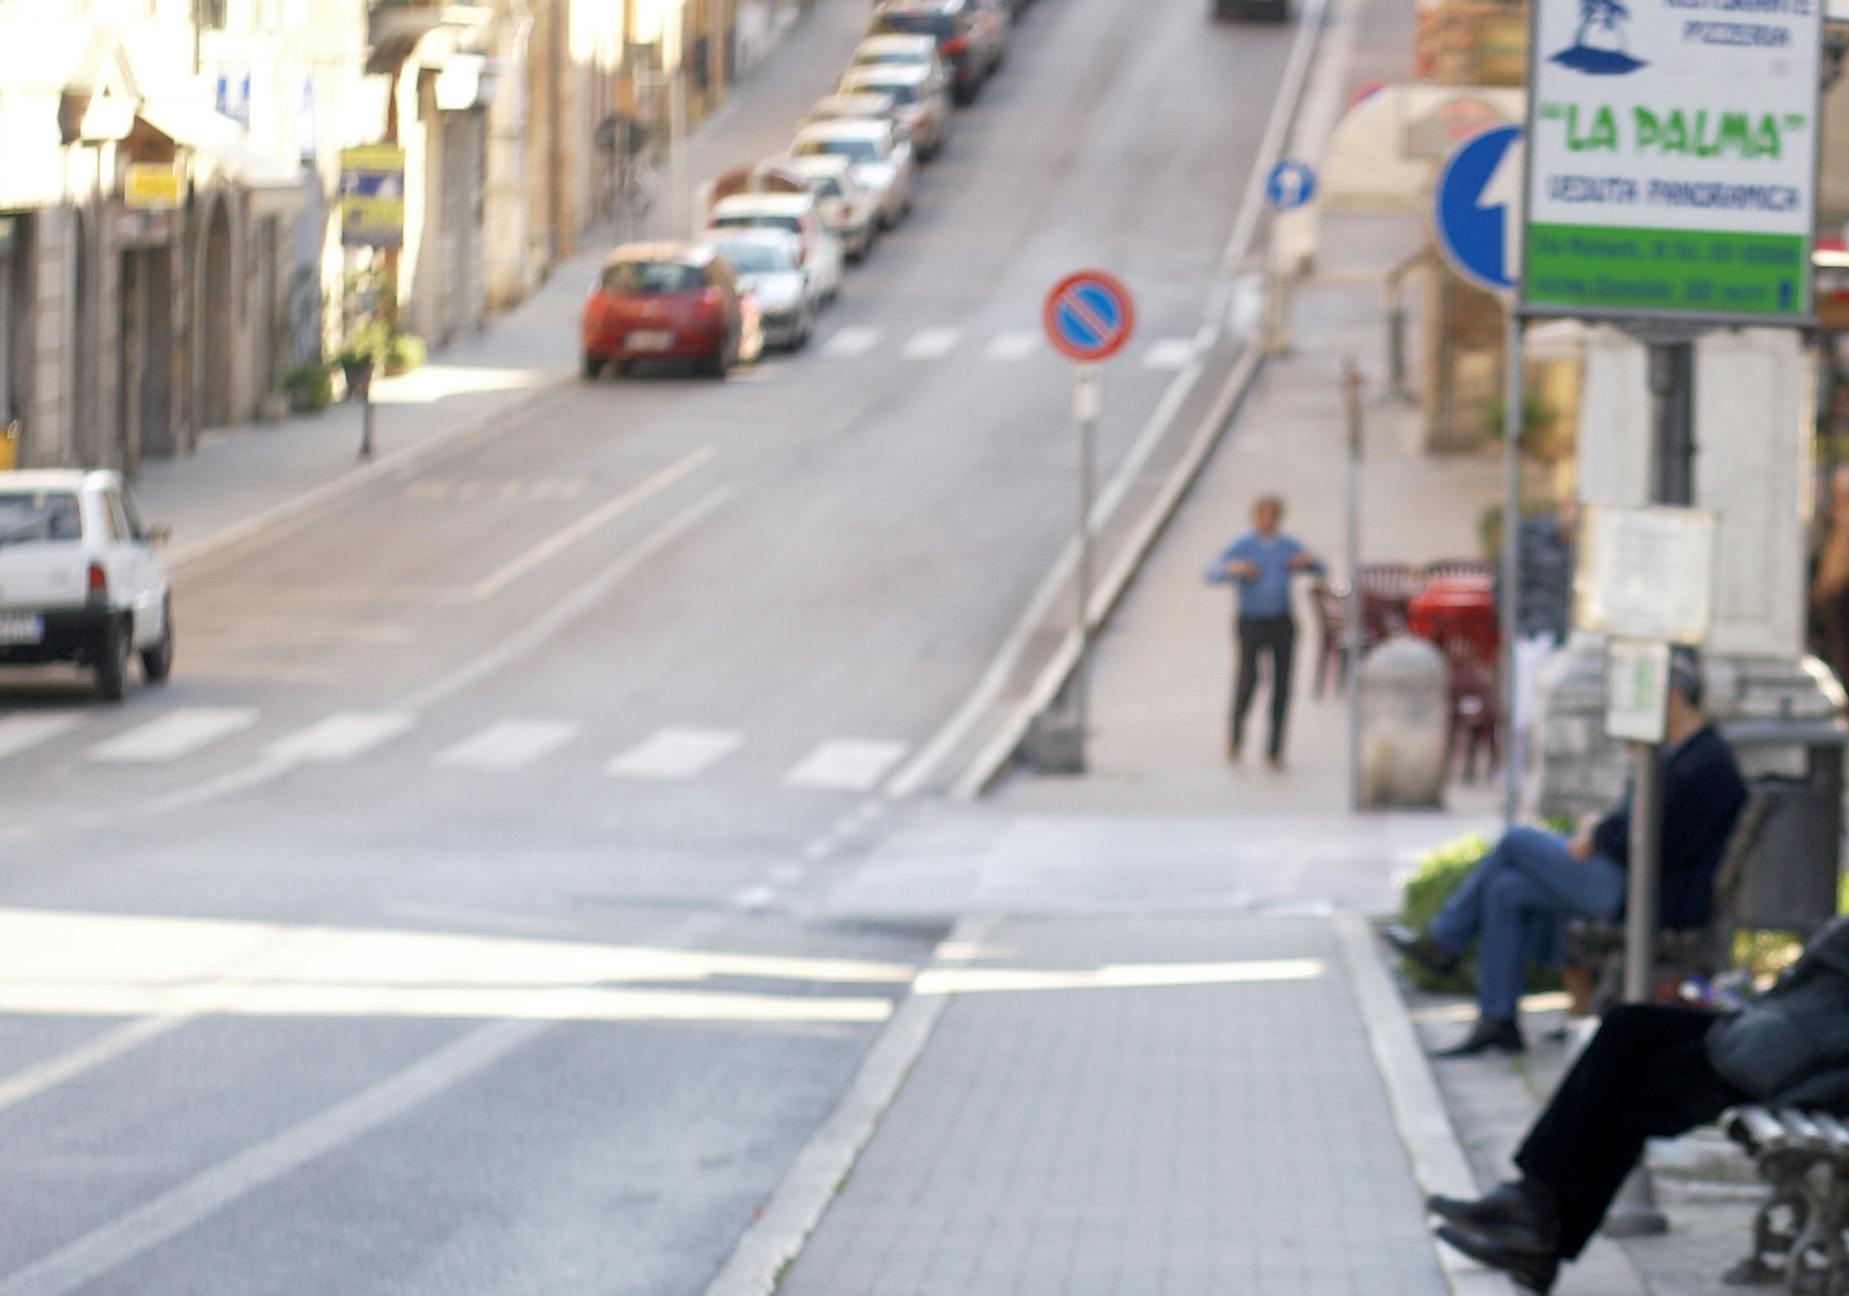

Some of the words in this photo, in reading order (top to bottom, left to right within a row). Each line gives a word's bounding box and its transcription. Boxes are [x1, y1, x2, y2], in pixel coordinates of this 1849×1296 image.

[1683, 20, 1790, 47] PIZZERIA
[1546, 174, 1638, 204] VEDUTA
[1647, 178, 1801, 213] PANORAMICA
